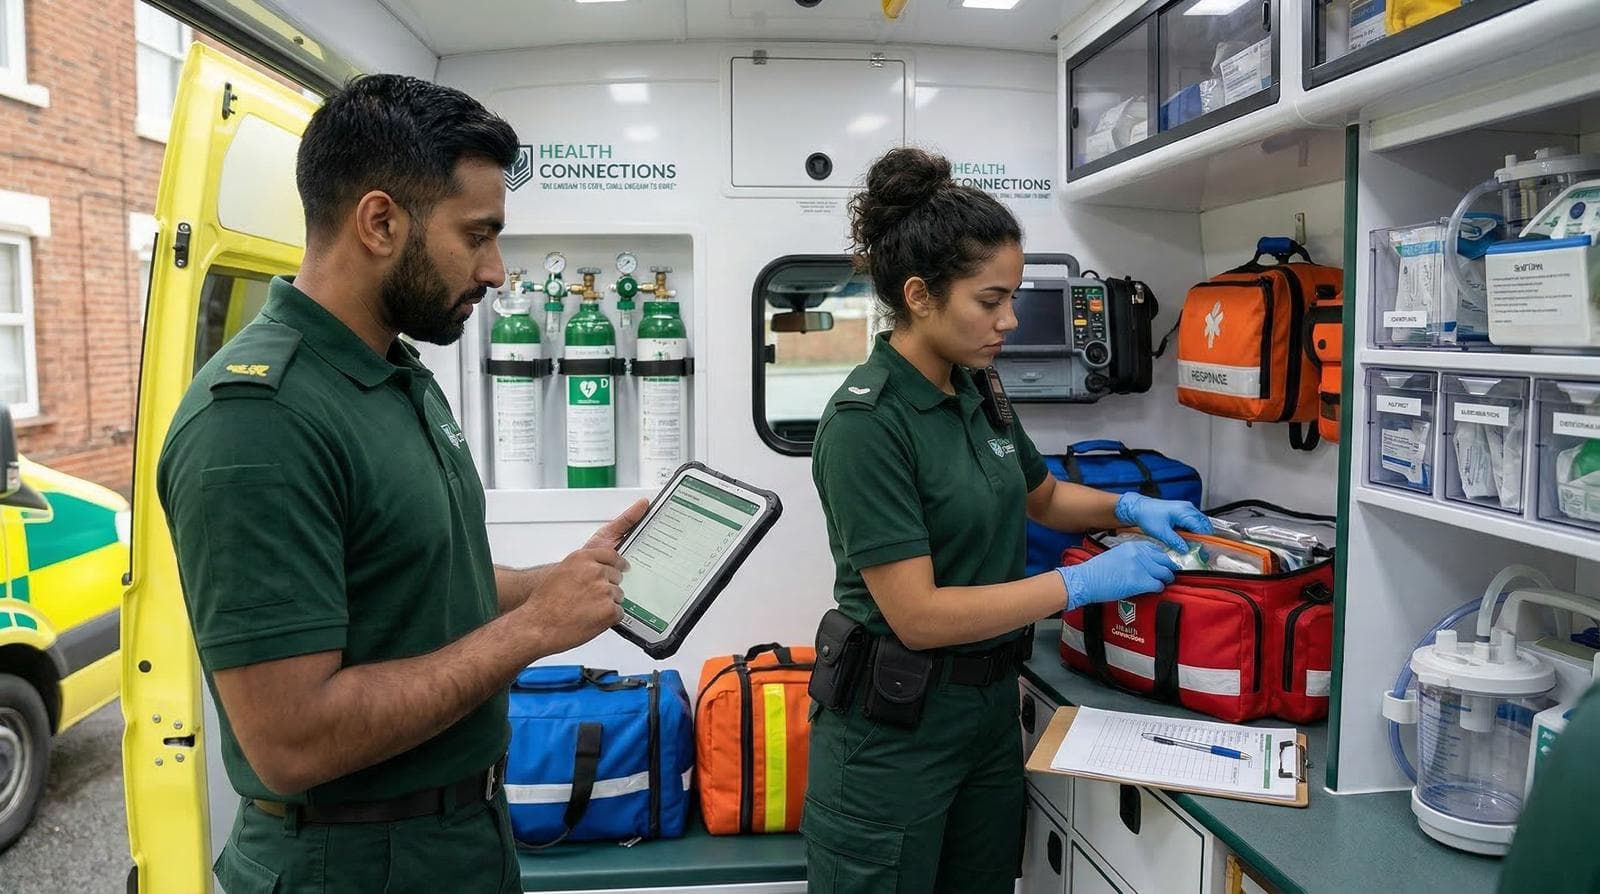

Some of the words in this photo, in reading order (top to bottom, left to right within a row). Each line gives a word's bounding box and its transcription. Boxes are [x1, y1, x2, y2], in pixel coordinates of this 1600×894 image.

[539, 144, 613, 159] HEALTH
[539, 163, 677, 179] CONNECTIONS
[953, 163, 1006, 175] HEALTH
[600, 377, 609, 389] D
